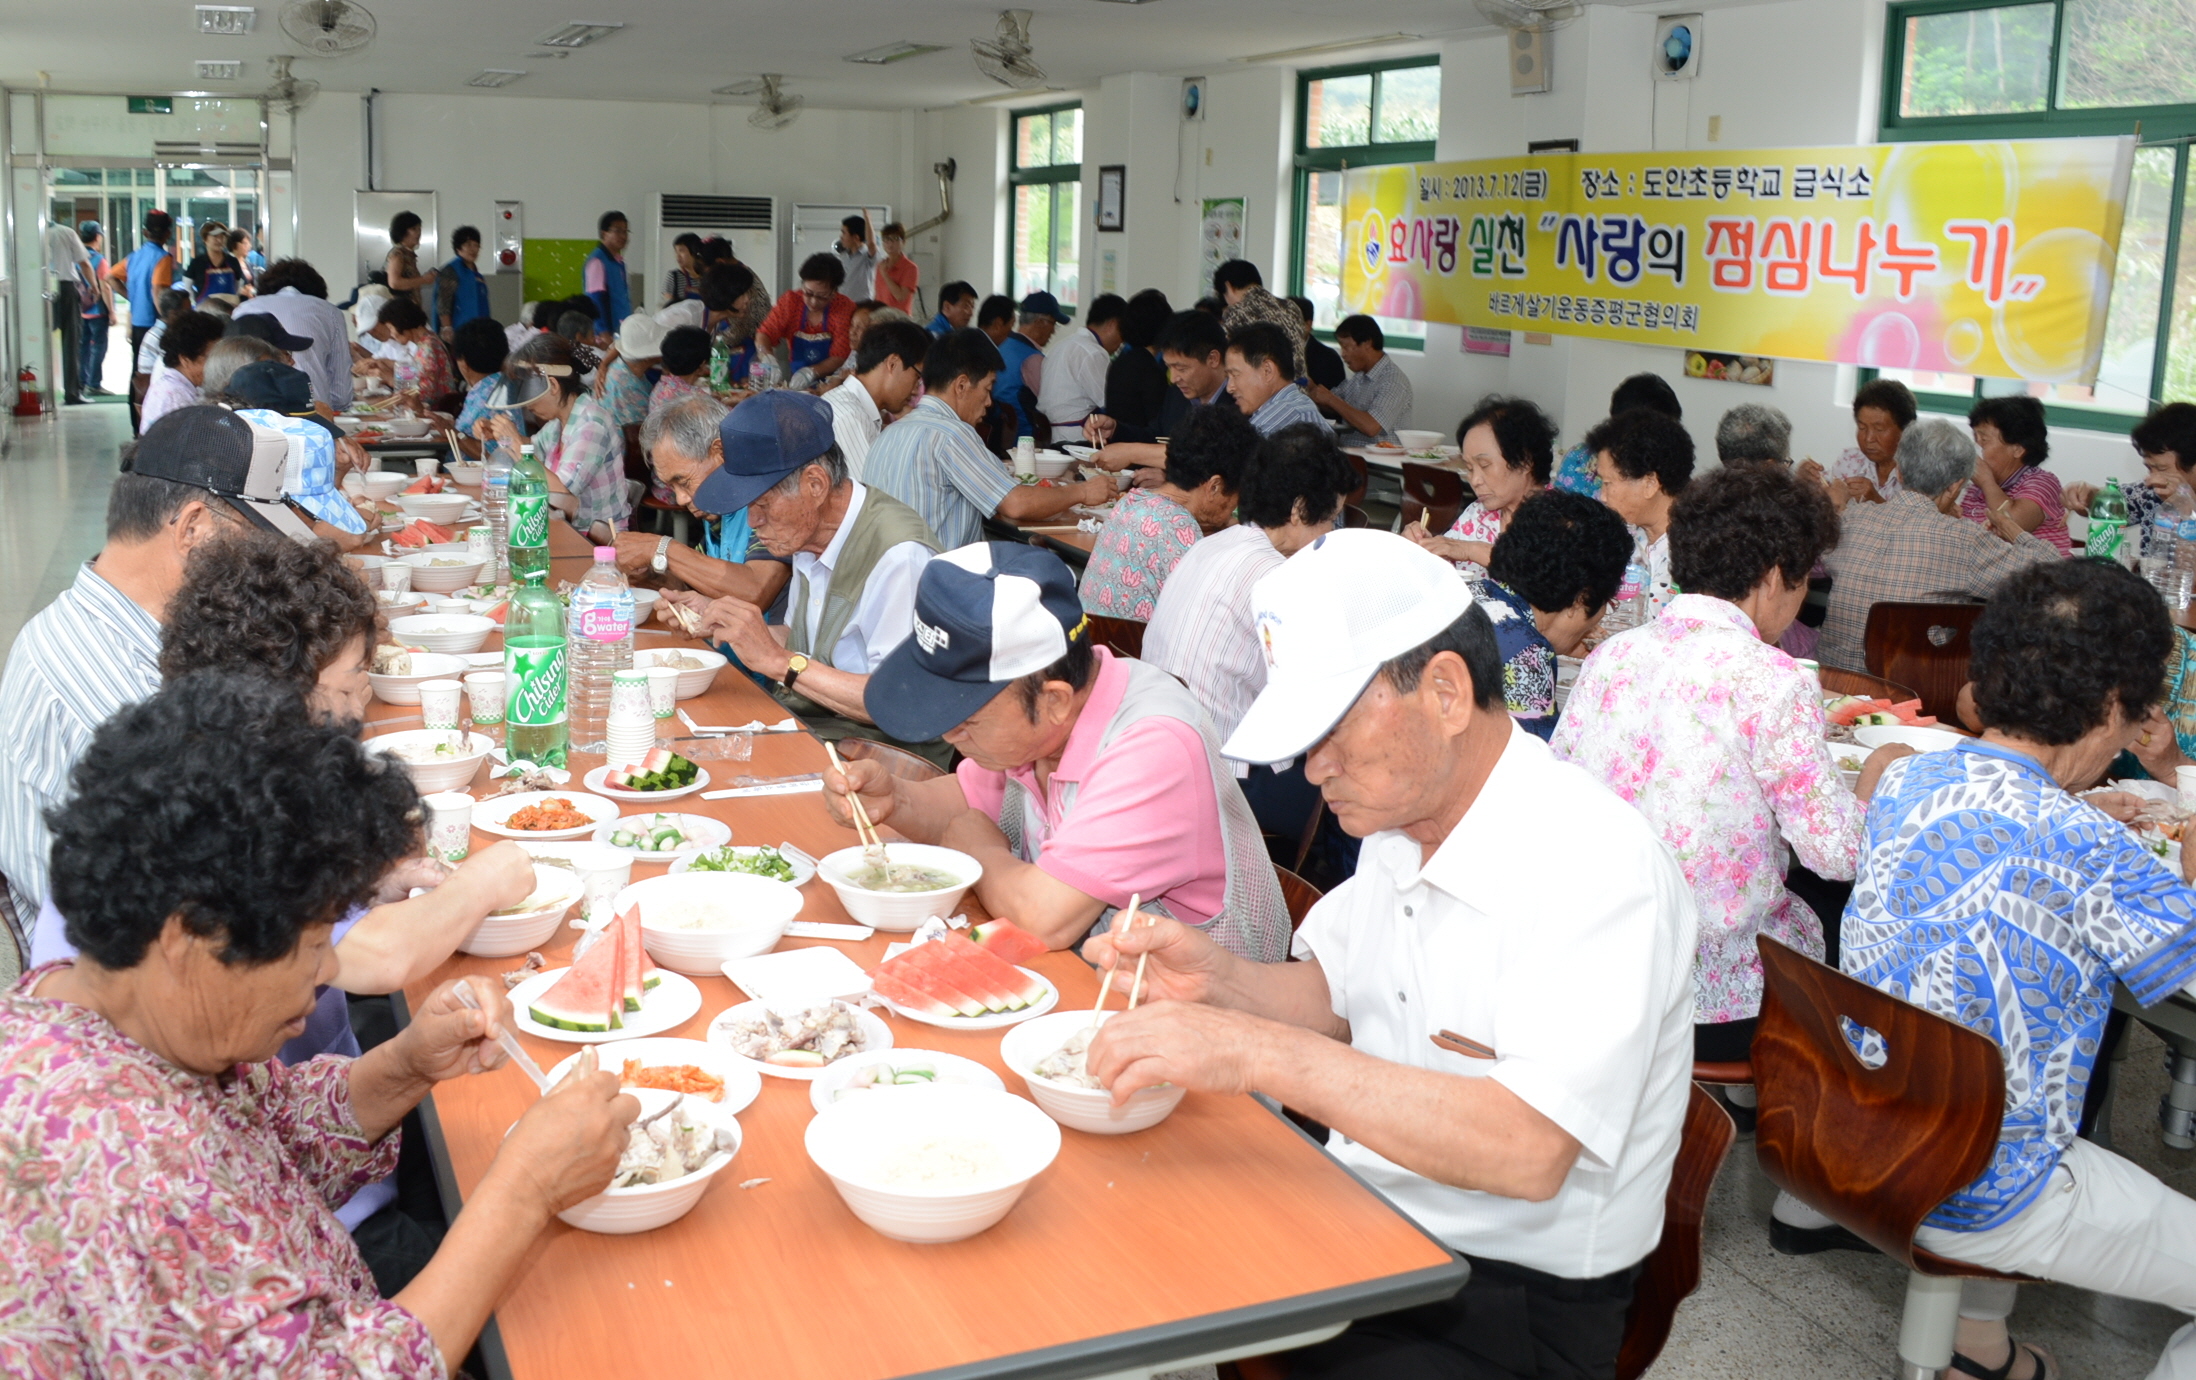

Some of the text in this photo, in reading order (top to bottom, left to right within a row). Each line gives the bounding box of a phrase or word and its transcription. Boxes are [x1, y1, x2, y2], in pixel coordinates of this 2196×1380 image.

[1420, 176, 1441, 201] 일시
[1581, 168, 1619, 199] 장소
[1642, 166, 1781, 199] 도안초등학교
[1793, 166, 1871, 198] 급식소
[1468, 213, 1525, 274] 실천
[516, 498, 548, 547] Chilsung
[1619, 584, 1638, 592] ater
[515, 648, 565, 723] Chilsung
[538, 673, 562, 717] Cider
